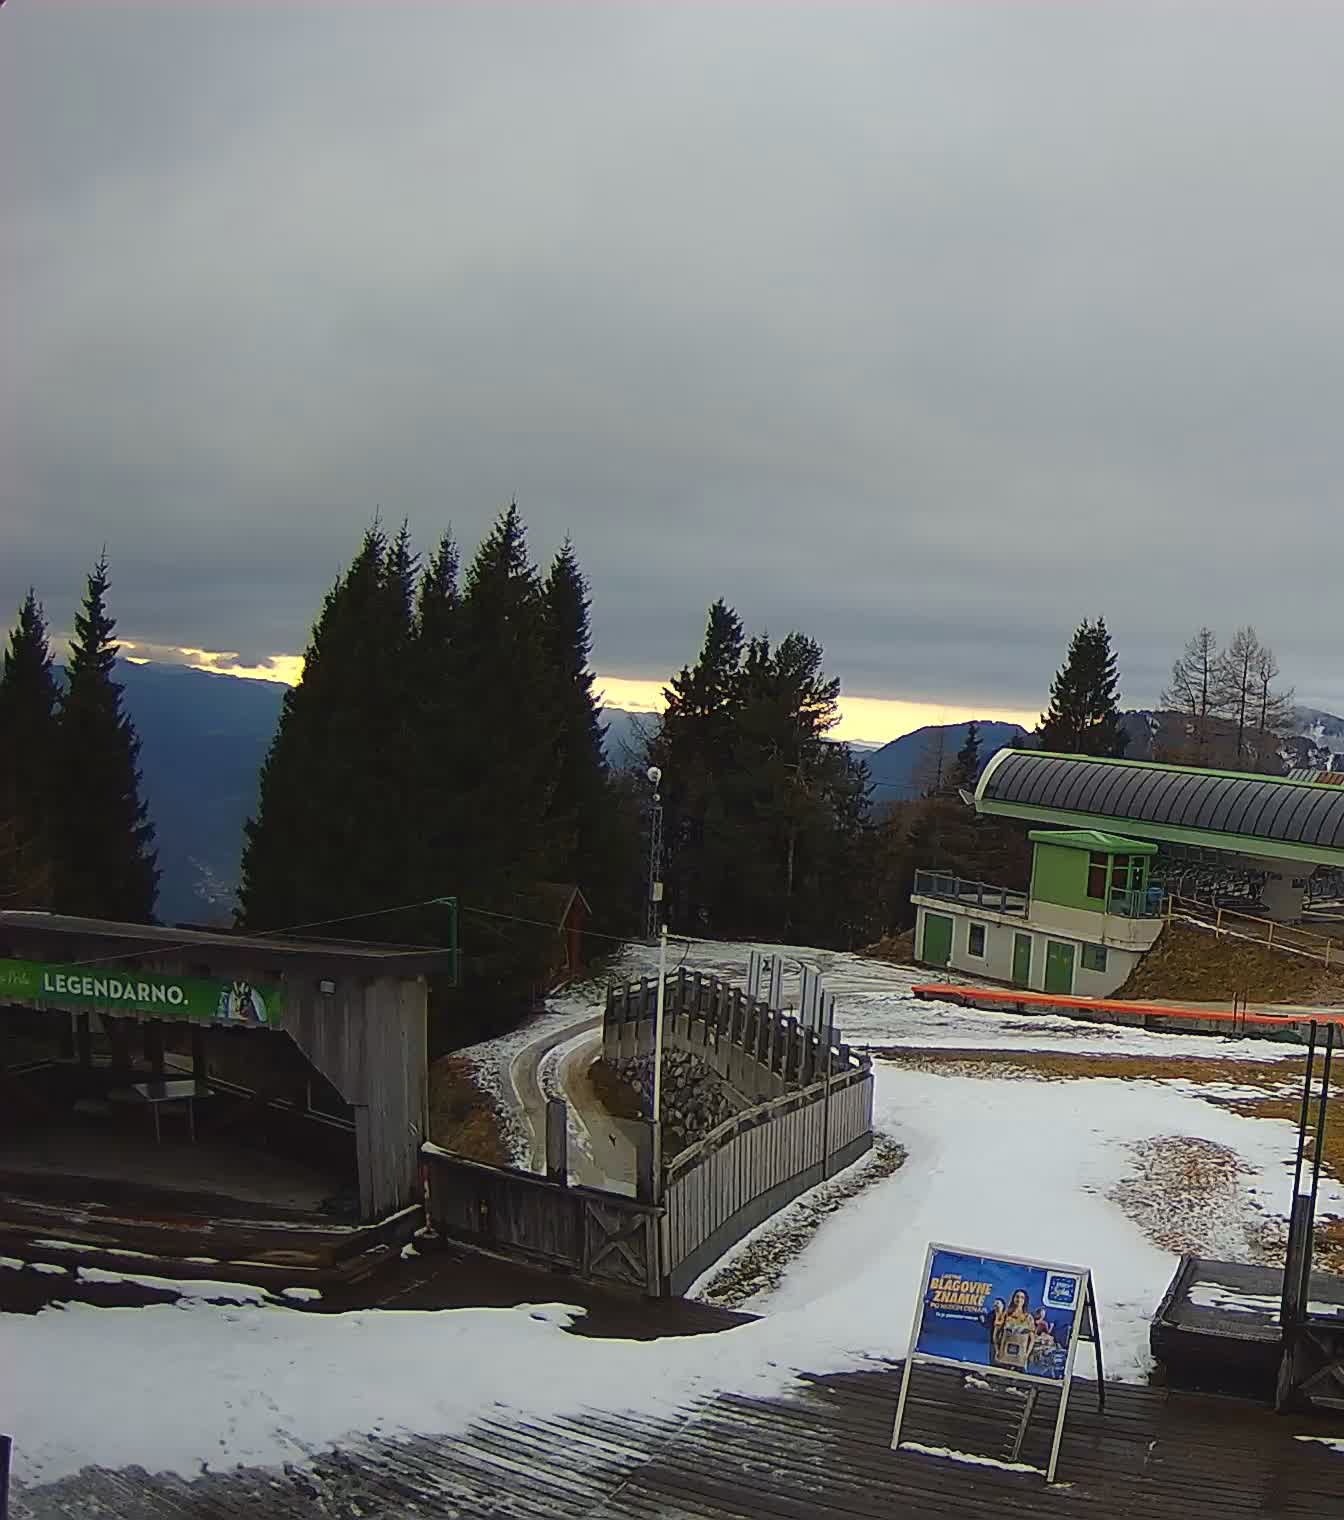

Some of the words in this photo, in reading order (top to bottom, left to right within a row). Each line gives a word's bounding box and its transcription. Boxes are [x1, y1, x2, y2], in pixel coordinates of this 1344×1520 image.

[43, 972, 189, 1005] LEGENDARNO.
[930, 1277, 993, 1295] BLAGOVNE
[932, 1290, 986, 1306] ZNAMKE
